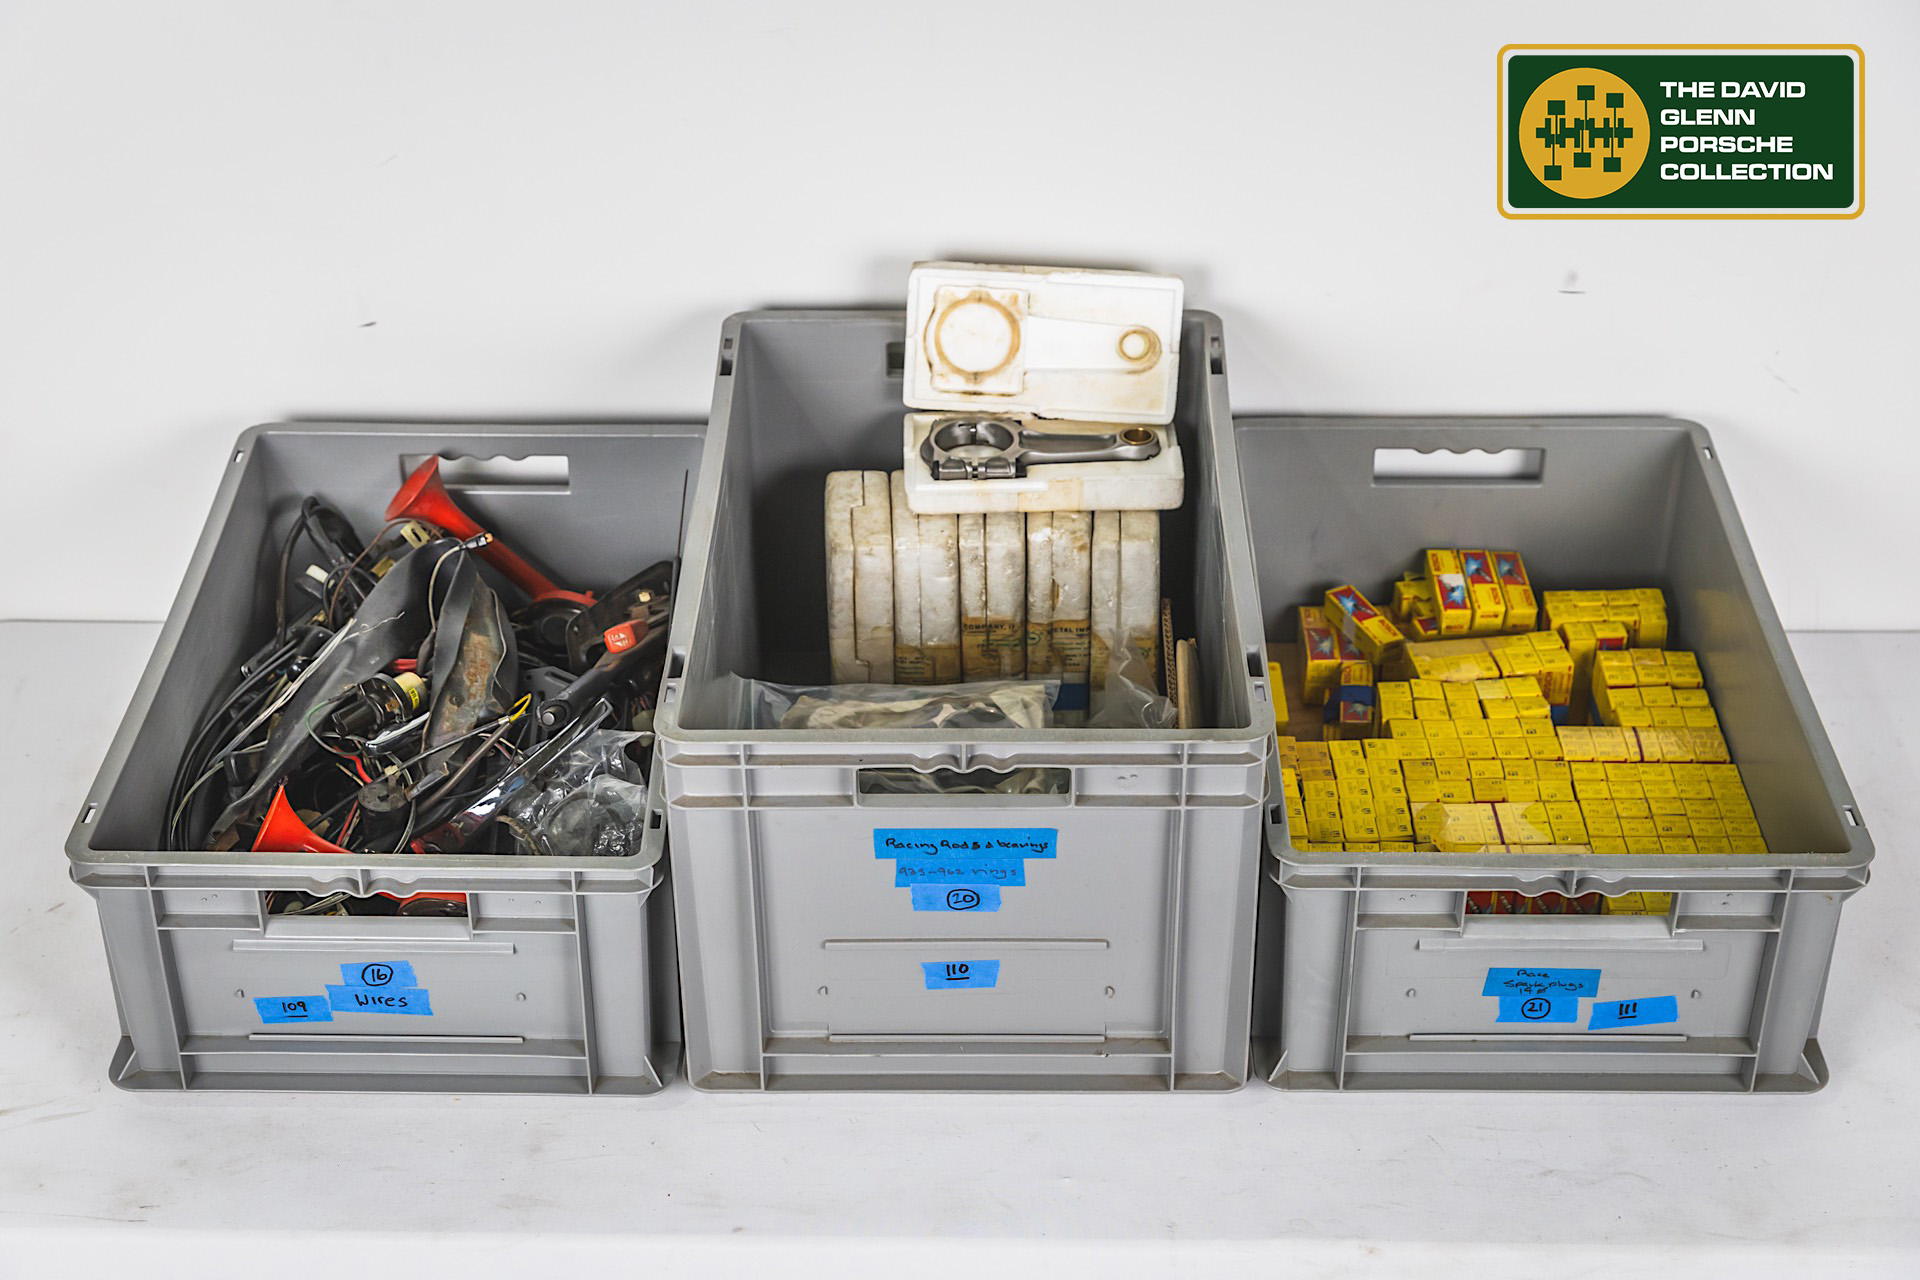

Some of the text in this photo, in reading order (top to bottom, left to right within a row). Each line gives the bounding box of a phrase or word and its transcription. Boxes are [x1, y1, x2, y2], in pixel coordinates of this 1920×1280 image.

[885, 837, 938, 855] Racing
[996, 836, 1049, 853] bearings
[972, 864, 1017, 879] rings
[945, 963, 970, 976] 110
[1516, 969, 1551, 979] Race
[1548, 980, 1584, 991] plugs
[281, 1000, 308, 1014] 109
[354, 993, 409, 1008] Wires
[1618, 1002, 1638, 1016] 111
